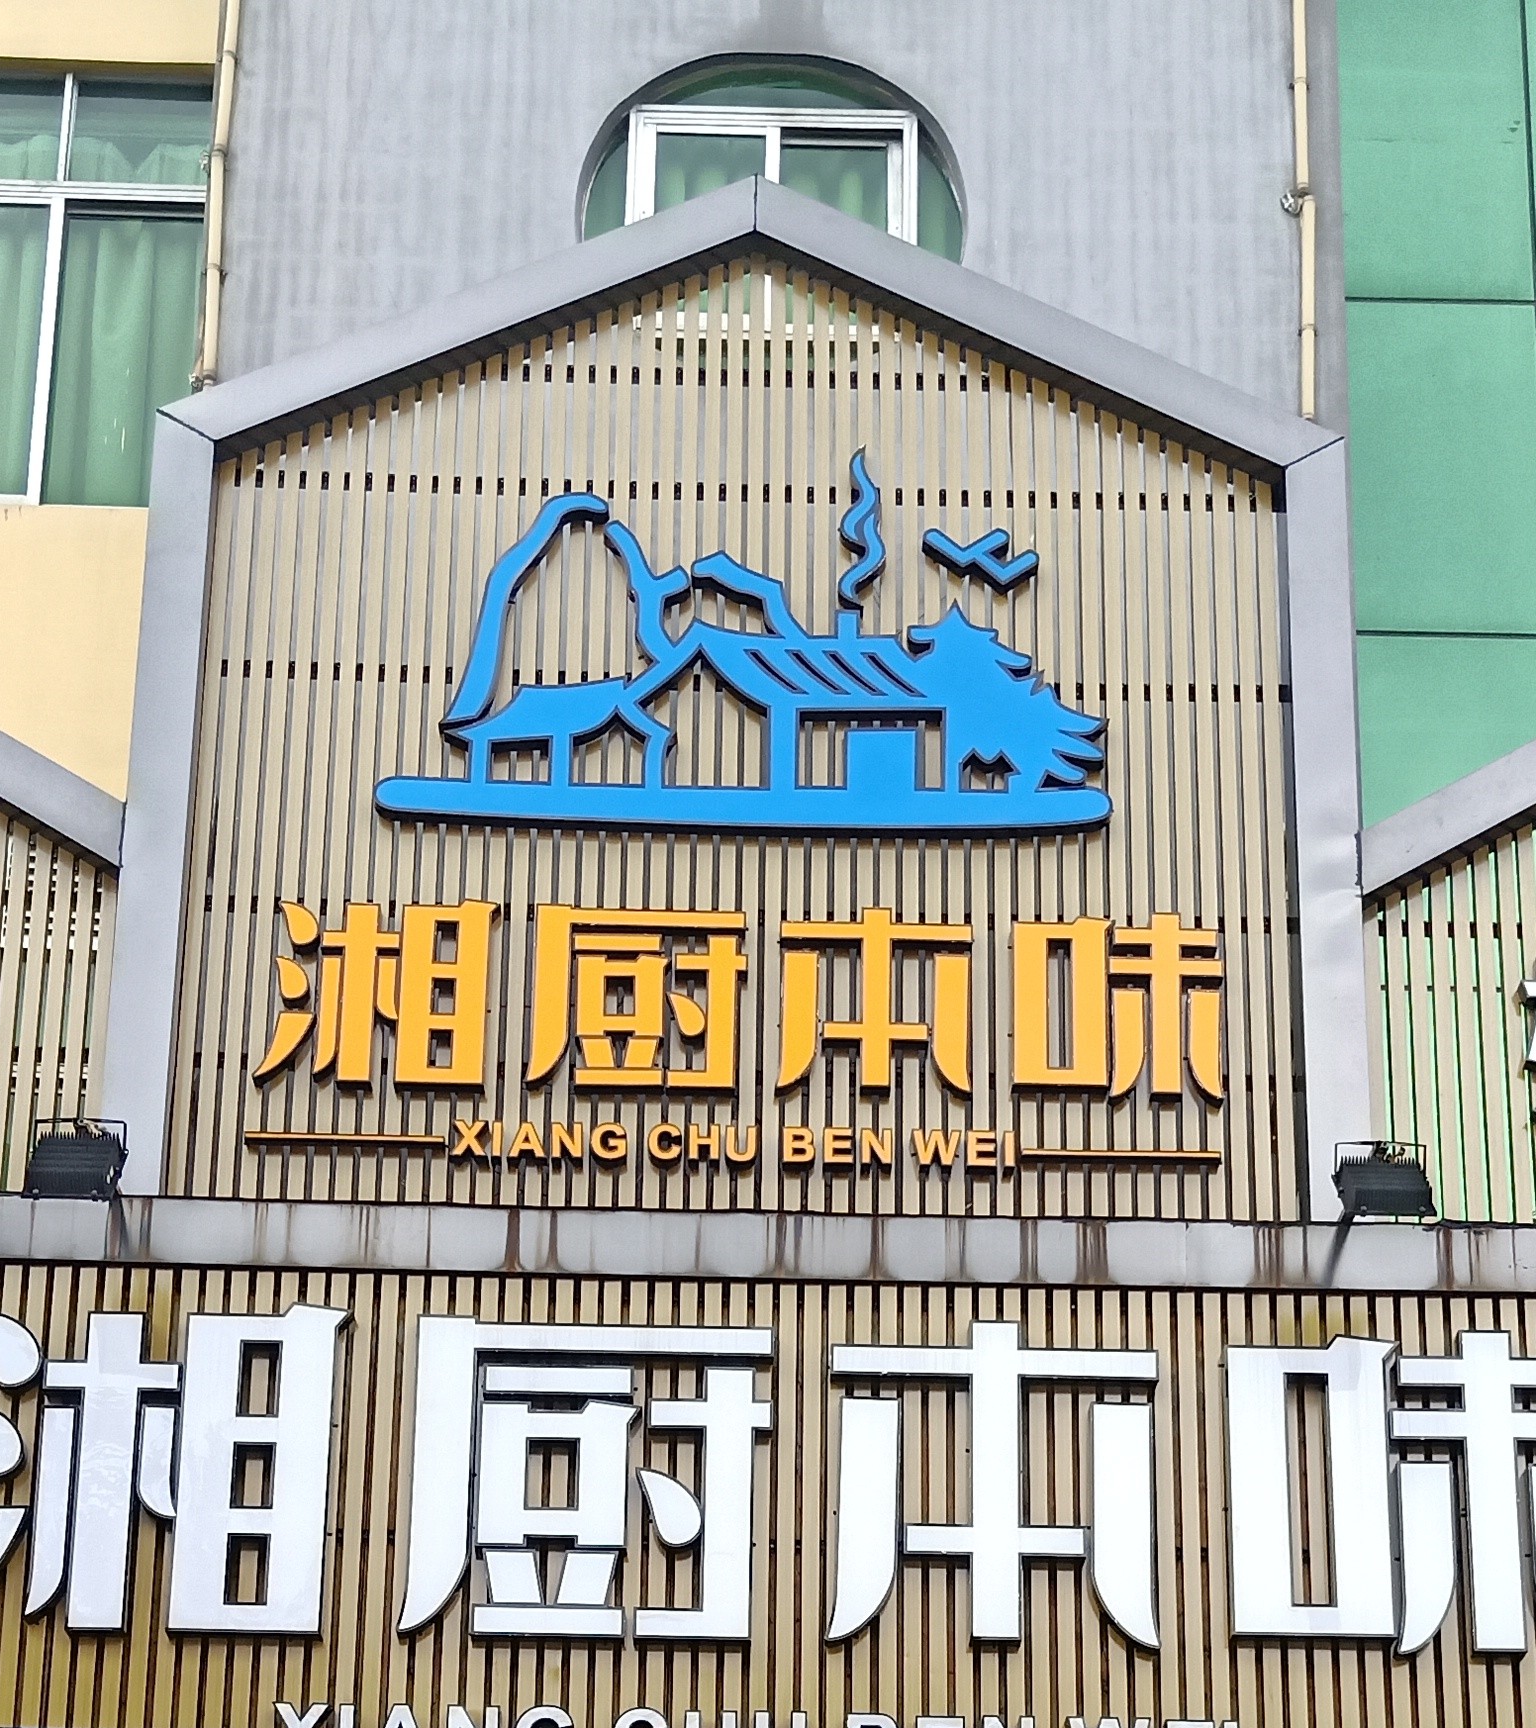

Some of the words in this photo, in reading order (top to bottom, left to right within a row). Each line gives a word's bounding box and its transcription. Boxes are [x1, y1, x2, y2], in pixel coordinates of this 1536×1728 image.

[252, 897, 1224, 1104] 湘厨本味
[448, 1119, 628, 1163] XIANG
[648, 1123, 757, 1167] CHU
[782, 1127, 894, 1168] BEN
[912, 1129, 1016, 1170] WEI
